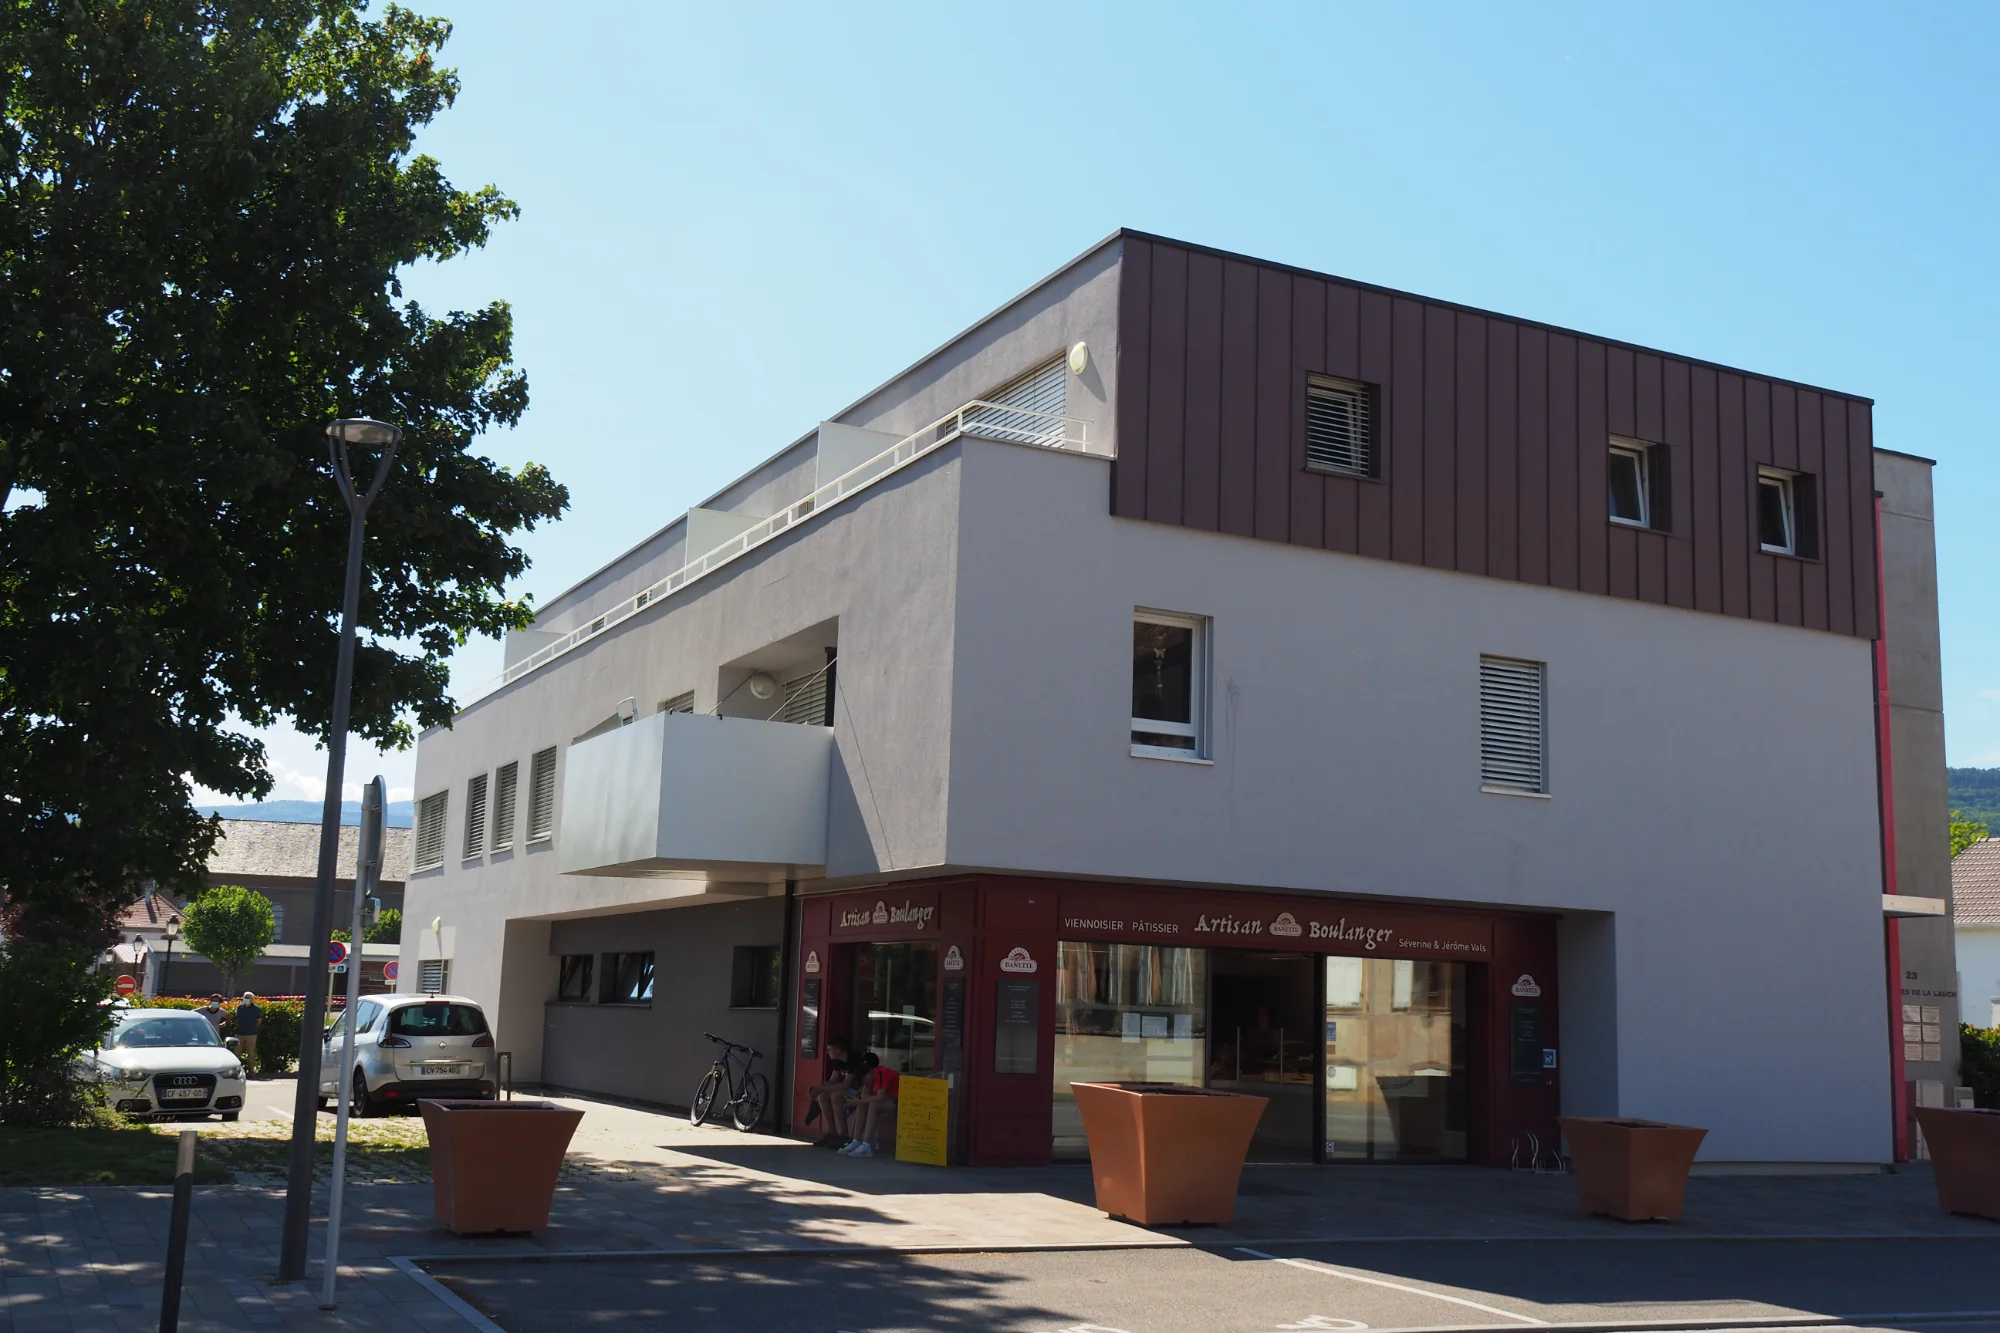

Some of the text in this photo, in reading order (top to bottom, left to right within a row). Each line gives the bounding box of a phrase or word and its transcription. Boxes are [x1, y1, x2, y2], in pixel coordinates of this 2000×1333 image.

[840, 899, 935, 930] Artisan Boulanger
[1064, 918, 1179, 934] VIENNOISIER PÂTISSIER
[1194, 914, 1393, 950] Artisan Boulanger
[1398, 938, 1432, 949] Séverine
[1441, 940, 1470, 951] Jérôme
[1470, 943, 1487, 952] Vals
[1004, 961, 1034, 969] BANETTE
[1905, 971, 1918, 980] 23
[1933, 990, 1957, 998] LAUCH
